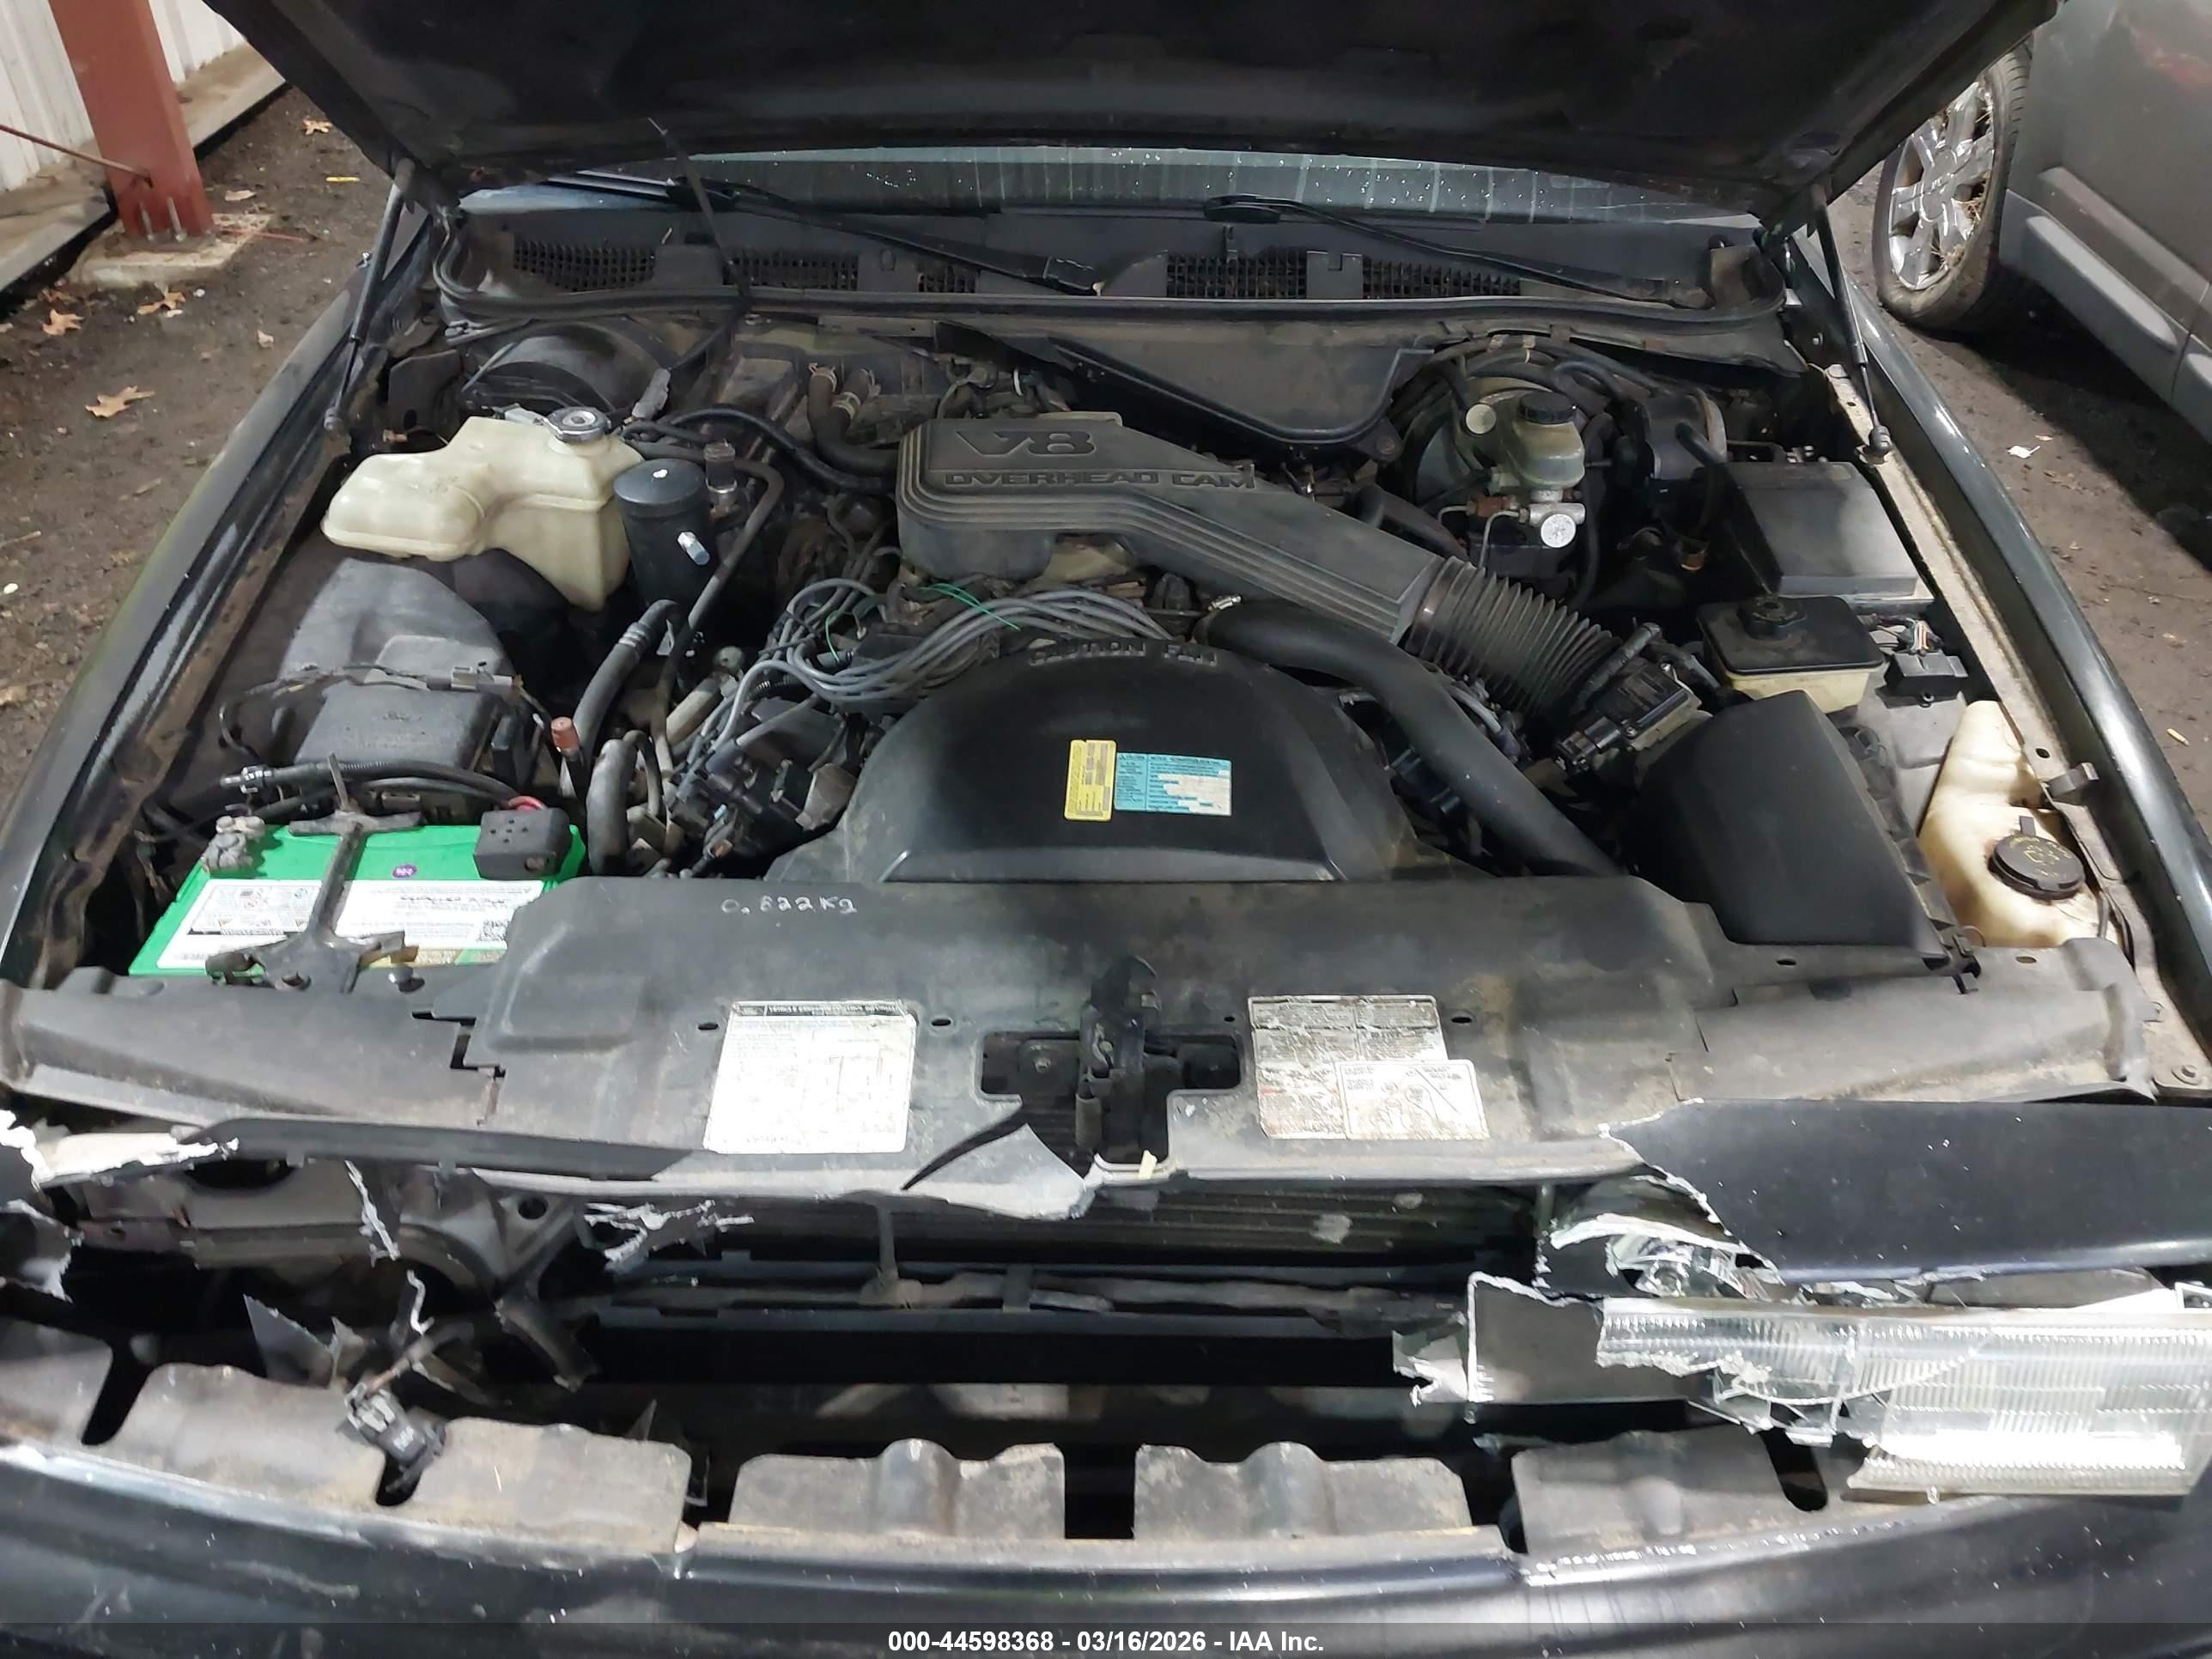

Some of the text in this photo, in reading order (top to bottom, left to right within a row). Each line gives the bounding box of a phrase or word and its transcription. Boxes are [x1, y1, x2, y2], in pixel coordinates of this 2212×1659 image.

[955, 430, 1097, 457] V8
[945, 470, 1255, 490] OVERHEAD CAM
